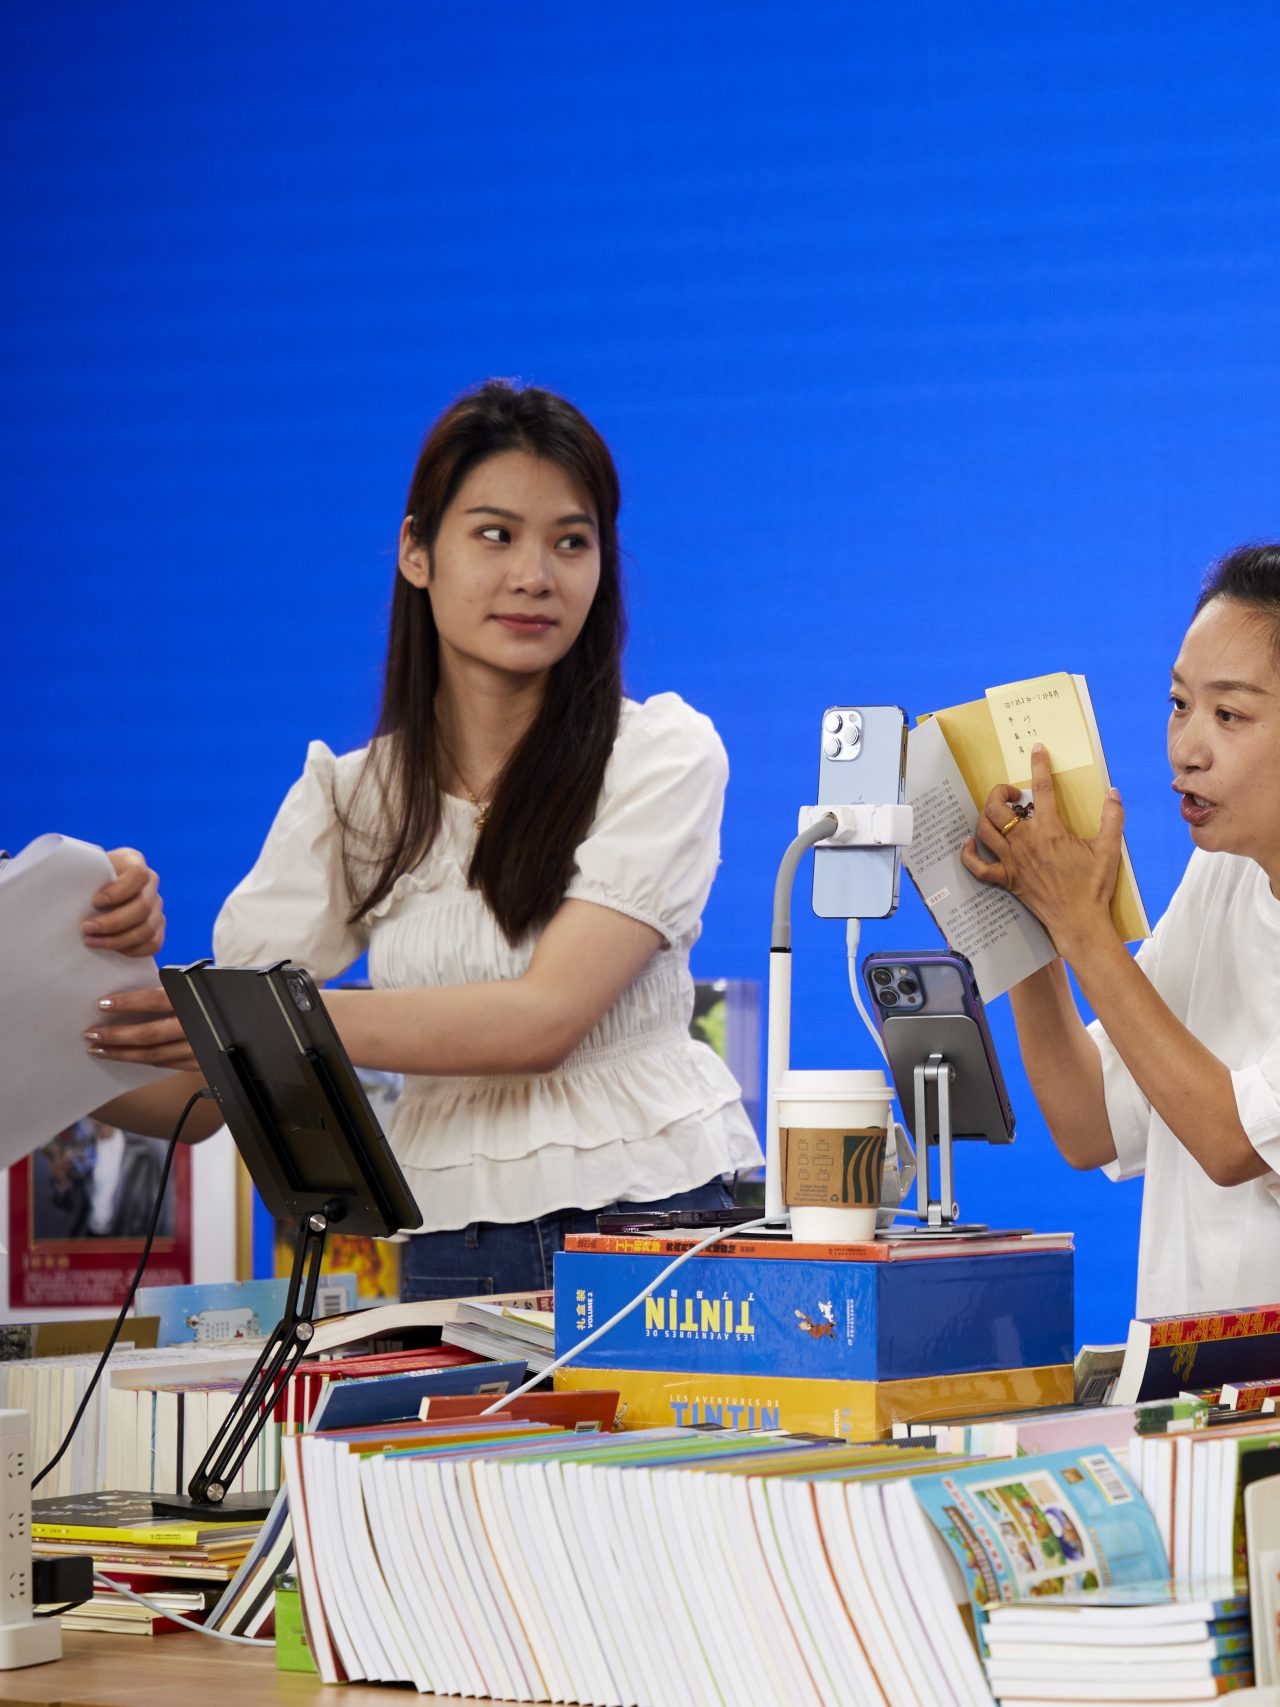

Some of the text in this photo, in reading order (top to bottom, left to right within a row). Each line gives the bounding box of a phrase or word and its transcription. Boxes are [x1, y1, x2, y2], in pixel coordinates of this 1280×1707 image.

[646, 1297, 754, 1334] TINTIN
[646, 1329, 754, 1342] LES AVENTURES DE
[669, 1394, 780, 1408] LES AVENTURES DE
[670, 1402, 780, 1430] TINTIN
